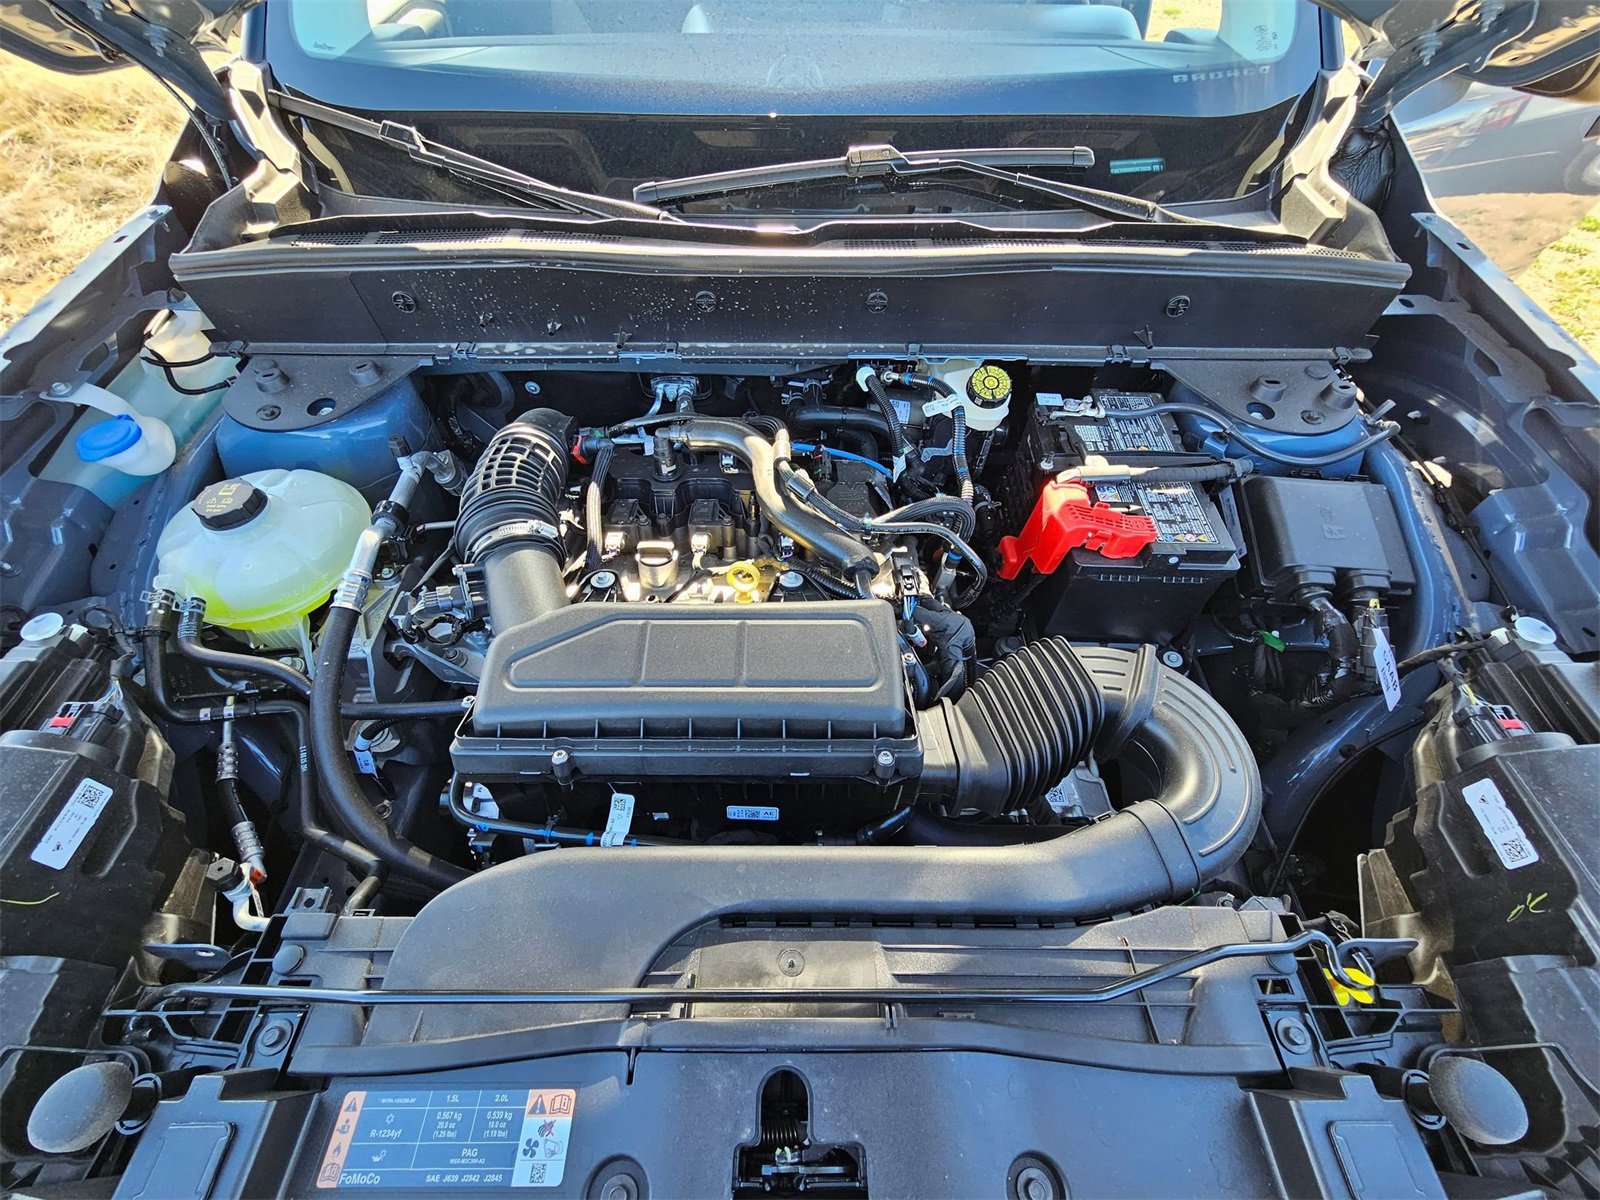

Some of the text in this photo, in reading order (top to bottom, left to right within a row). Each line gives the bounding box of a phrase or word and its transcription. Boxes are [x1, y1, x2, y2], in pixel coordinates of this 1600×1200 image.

[447, 1094, 460, 1103] 1.5L
[494, 1094, 509, 1102] 2.0L
[436, 1111, 463, 1121] 0.567 kg
[504, 1111, 513, 1121] kg
[370, 1129, 402, 1140] R-1234yf
[461, 1148, 478, 1157] PAG
[338, 1172, 380, 1184] FoMoCo
[426, 1174, 441, 1182] SAE
[443, 1174, 459, 1182] J639
[461, 1174, 480, 1182] J2842
